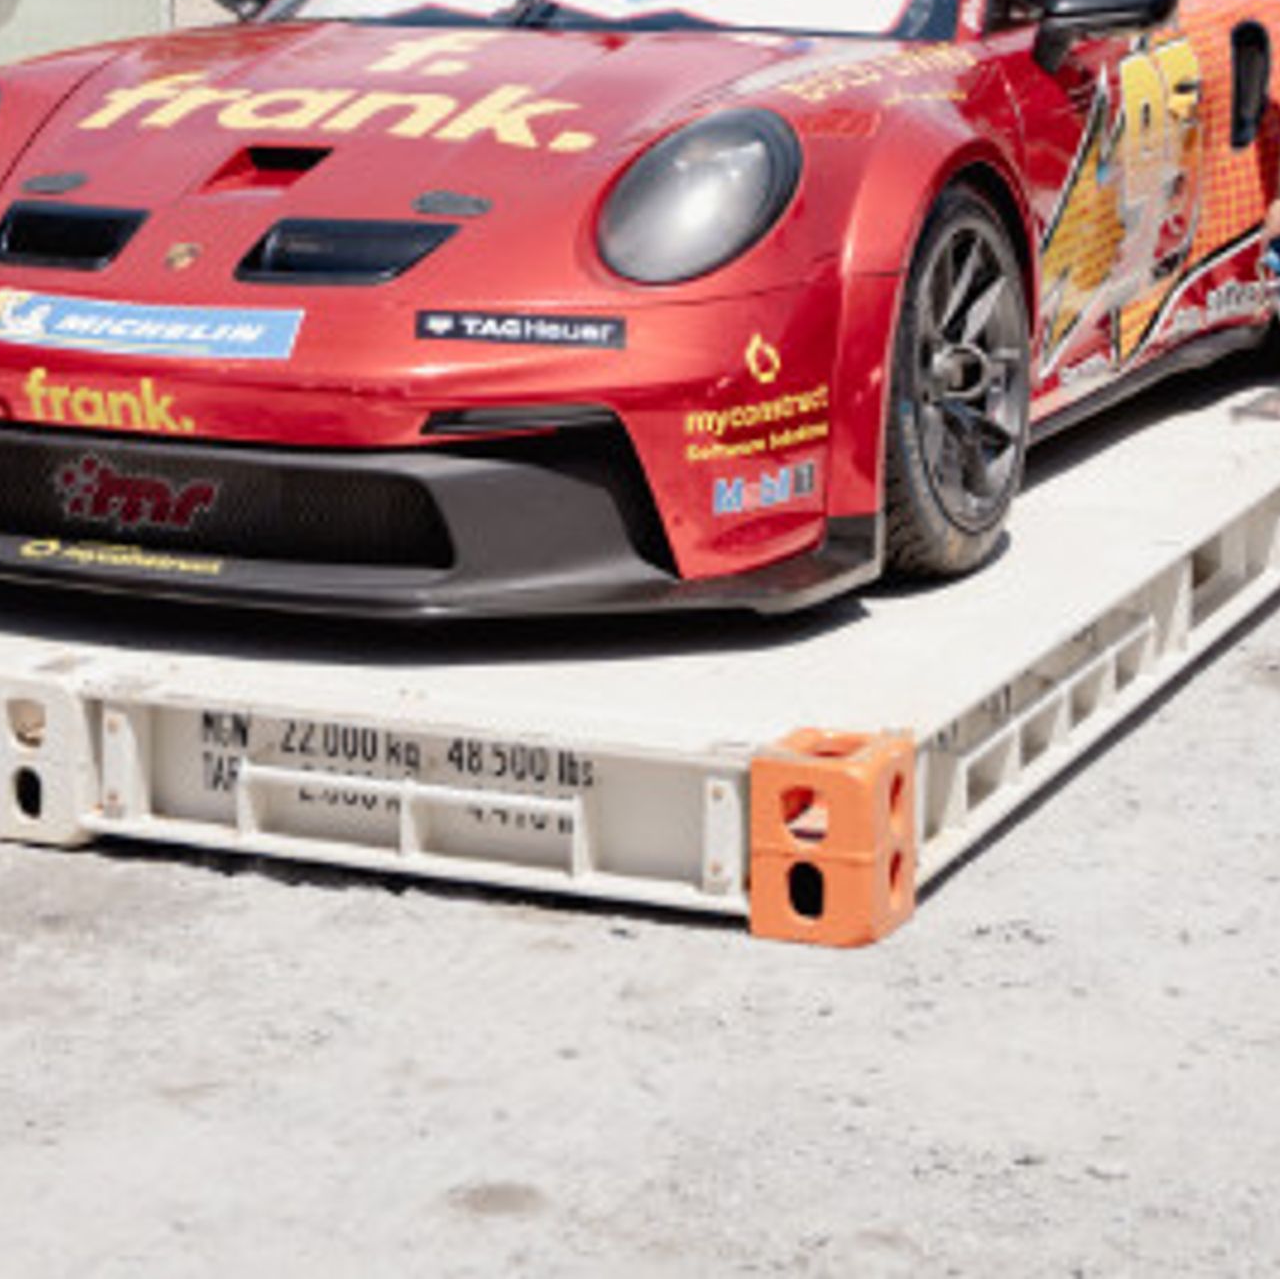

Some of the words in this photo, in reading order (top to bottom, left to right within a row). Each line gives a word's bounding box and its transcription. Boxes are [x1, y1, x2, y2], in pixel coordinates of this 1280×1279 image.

[77, 71, 597, 152] frank.
[54, 315, 264, 342] MICHELIN
[24, 367, 195, 432] frank.
